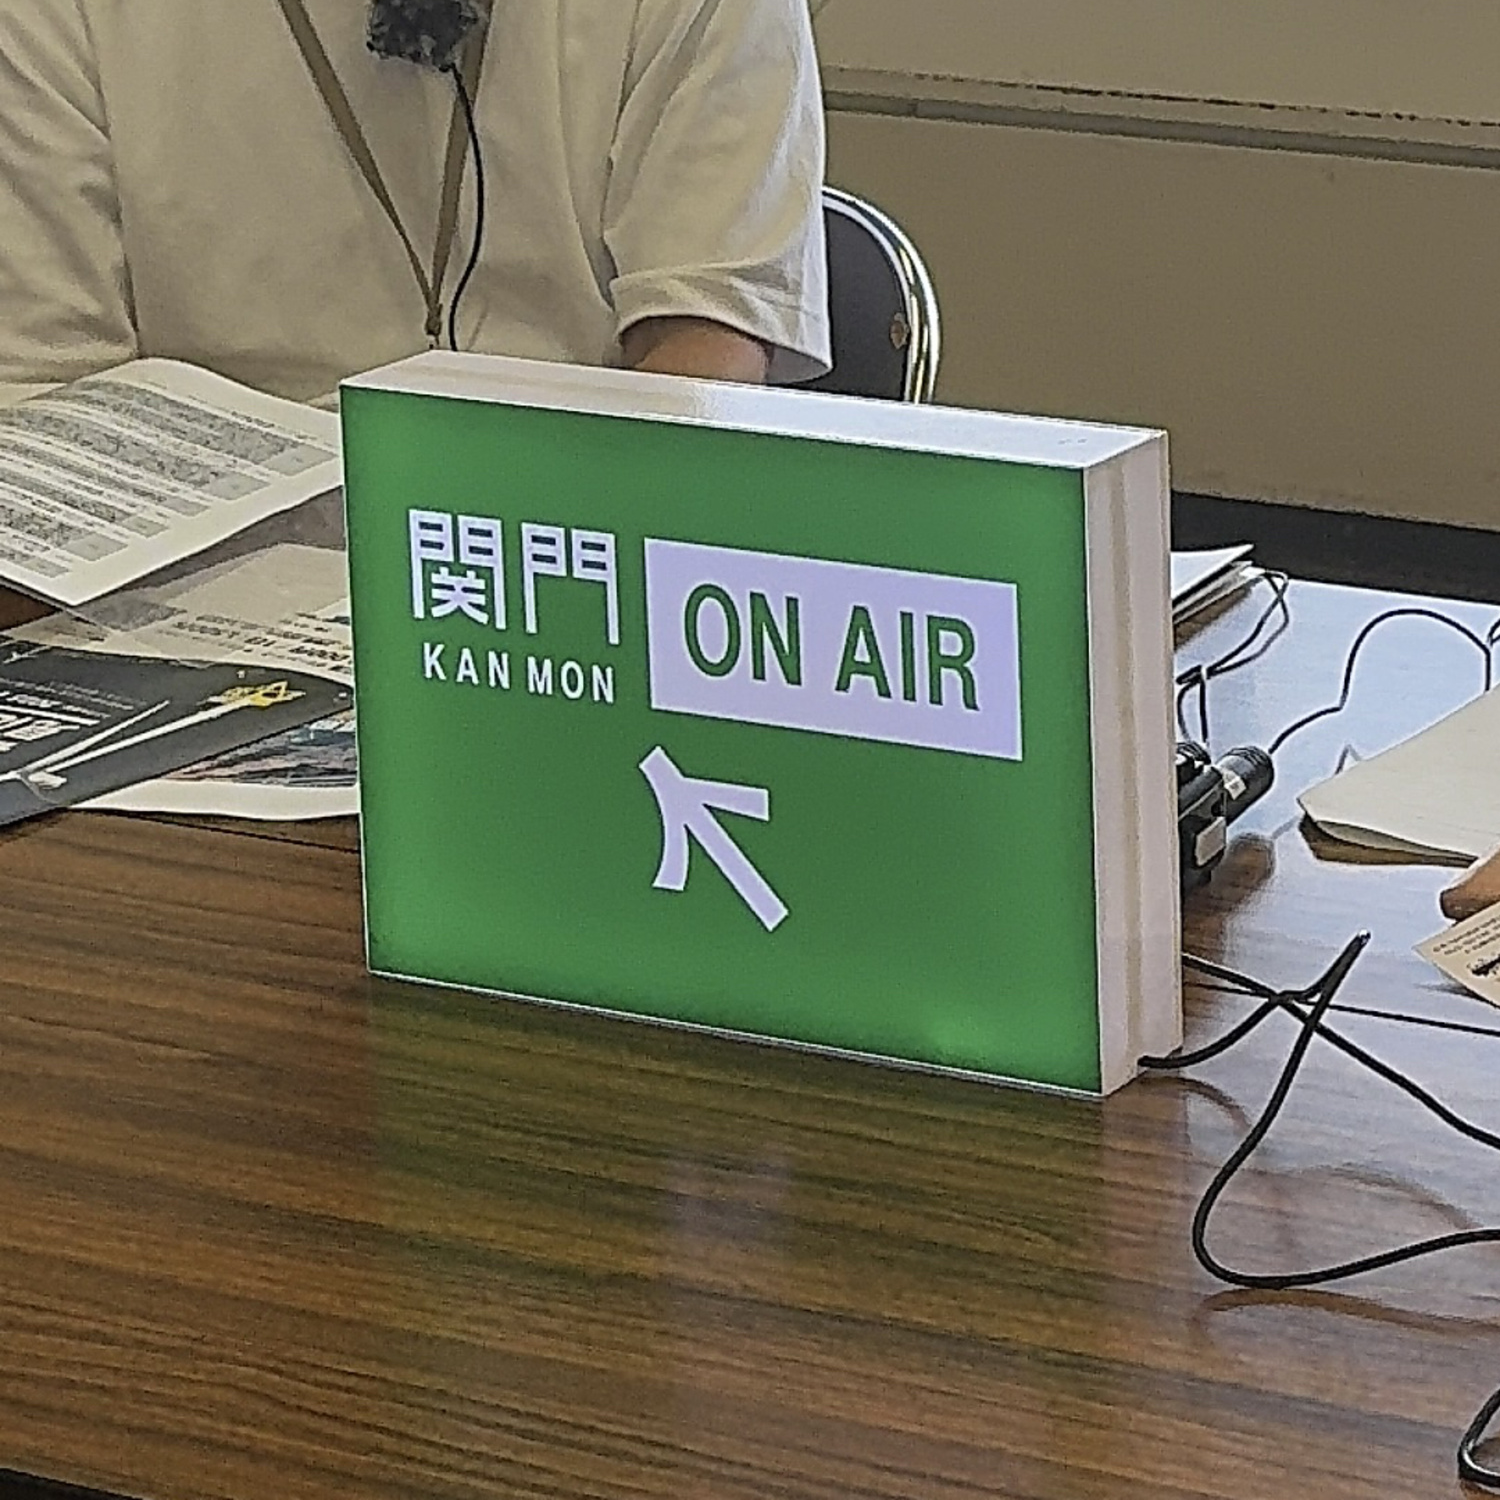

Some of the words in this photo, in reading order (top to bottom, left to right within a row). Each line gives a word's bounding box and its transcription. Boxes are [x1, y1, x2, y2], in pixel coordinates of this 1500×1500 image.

[408, 508, 621, 645] 関門
[684, 584, 802, 687] ON
[836, 605, 980, 713] AIR
